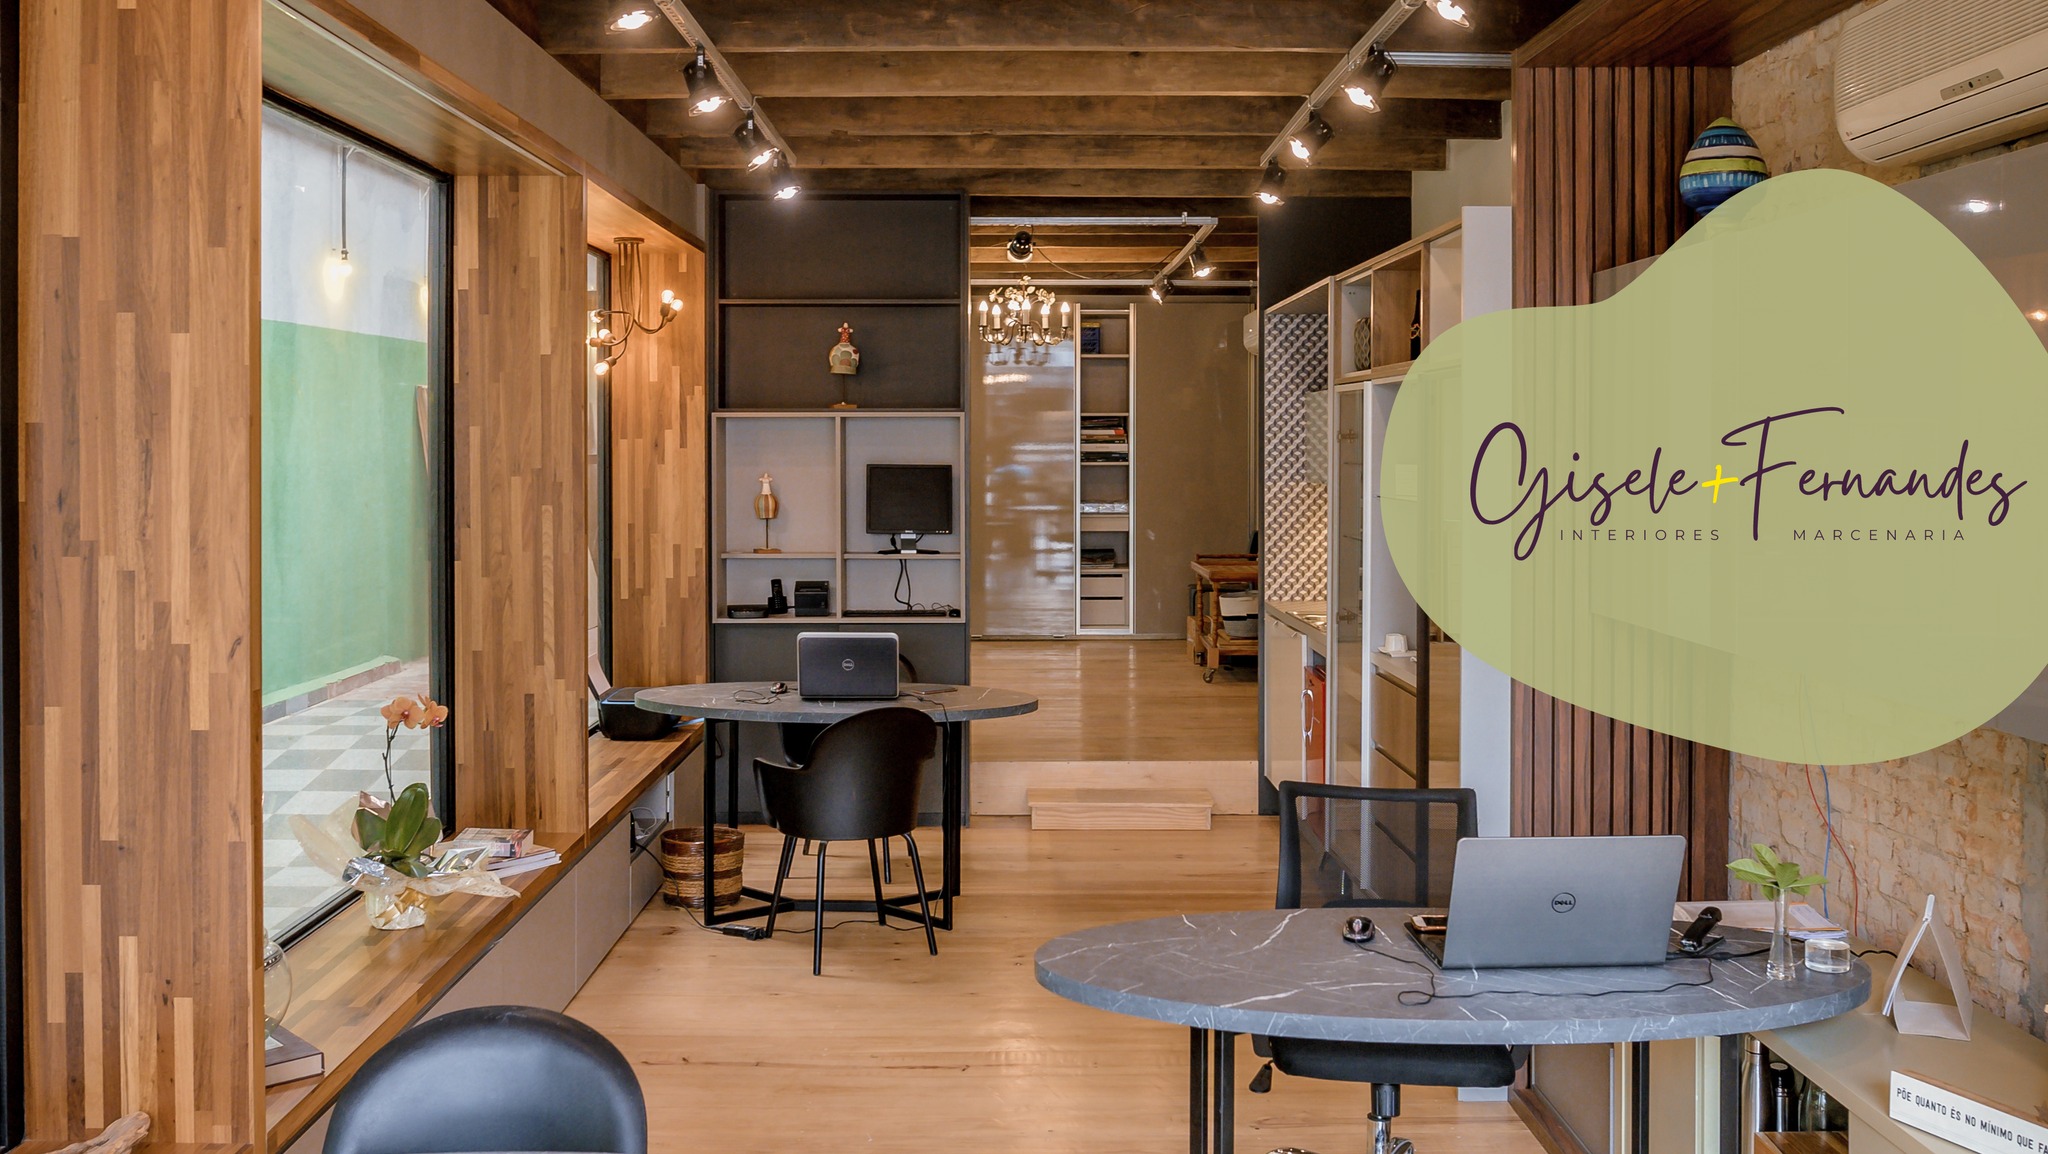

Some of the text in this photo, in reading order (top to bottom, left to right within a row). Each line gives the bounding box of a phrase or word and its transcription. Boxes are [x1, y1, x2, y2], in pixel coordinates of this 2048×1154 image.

[1915, 1095, 1947, 1115] QUANTO
[1950, 1106, 1961, 1121] ÉS
[1965, 1114, 1977, 1127] NO
[1980, 1120, 2013, 1141] MÍNIMO
[2016, 1134, 2034, 1150] QUE
